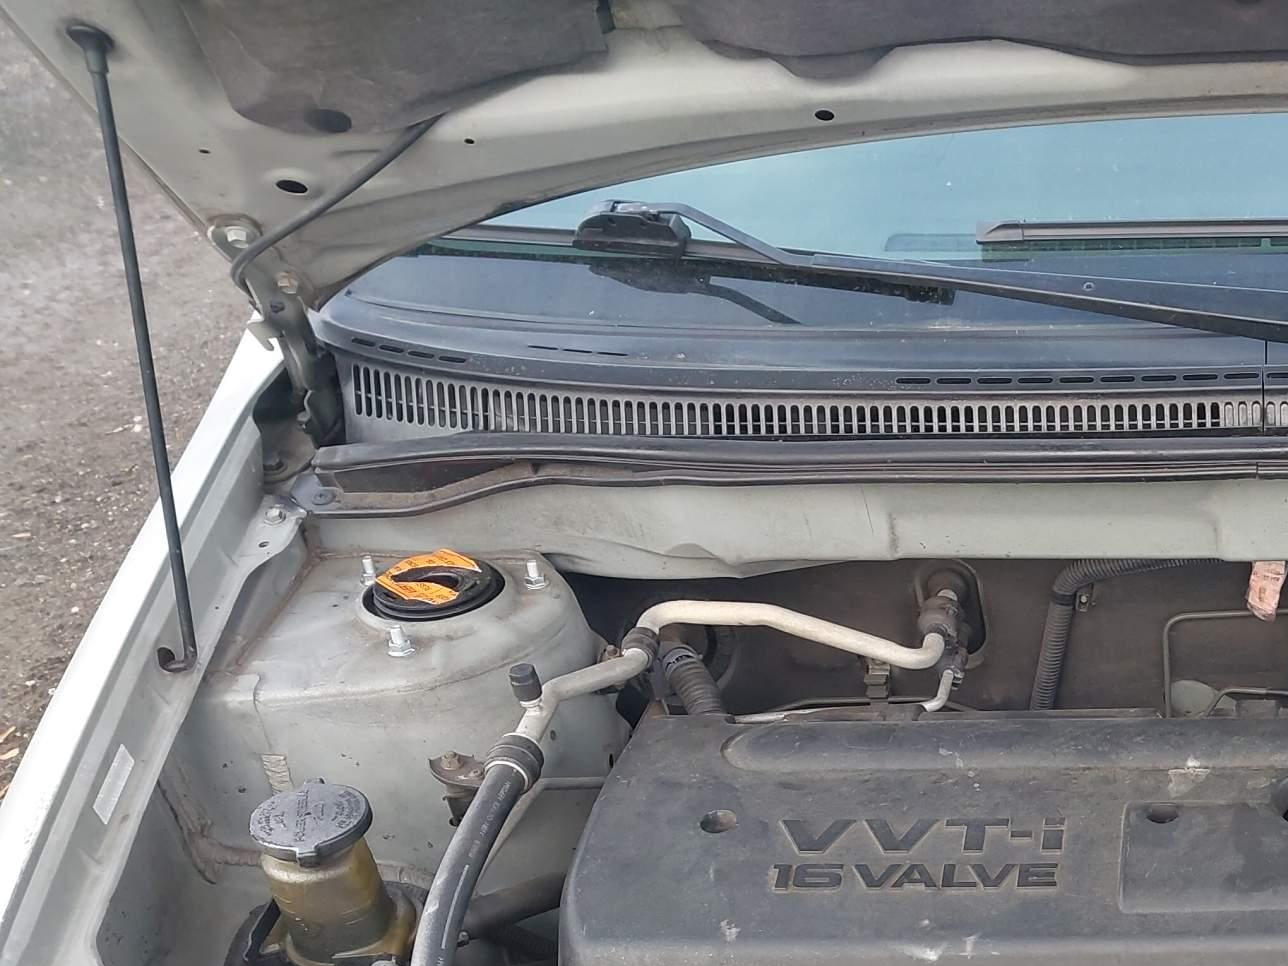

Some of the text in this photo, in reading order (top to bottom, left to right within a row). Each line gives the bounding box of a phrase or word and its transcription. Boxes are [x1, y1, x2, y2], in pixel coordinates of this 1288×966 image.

[779, 817, 1067, 856] VVT-i
[772, 863, 1059, 892] 16 VALVE
